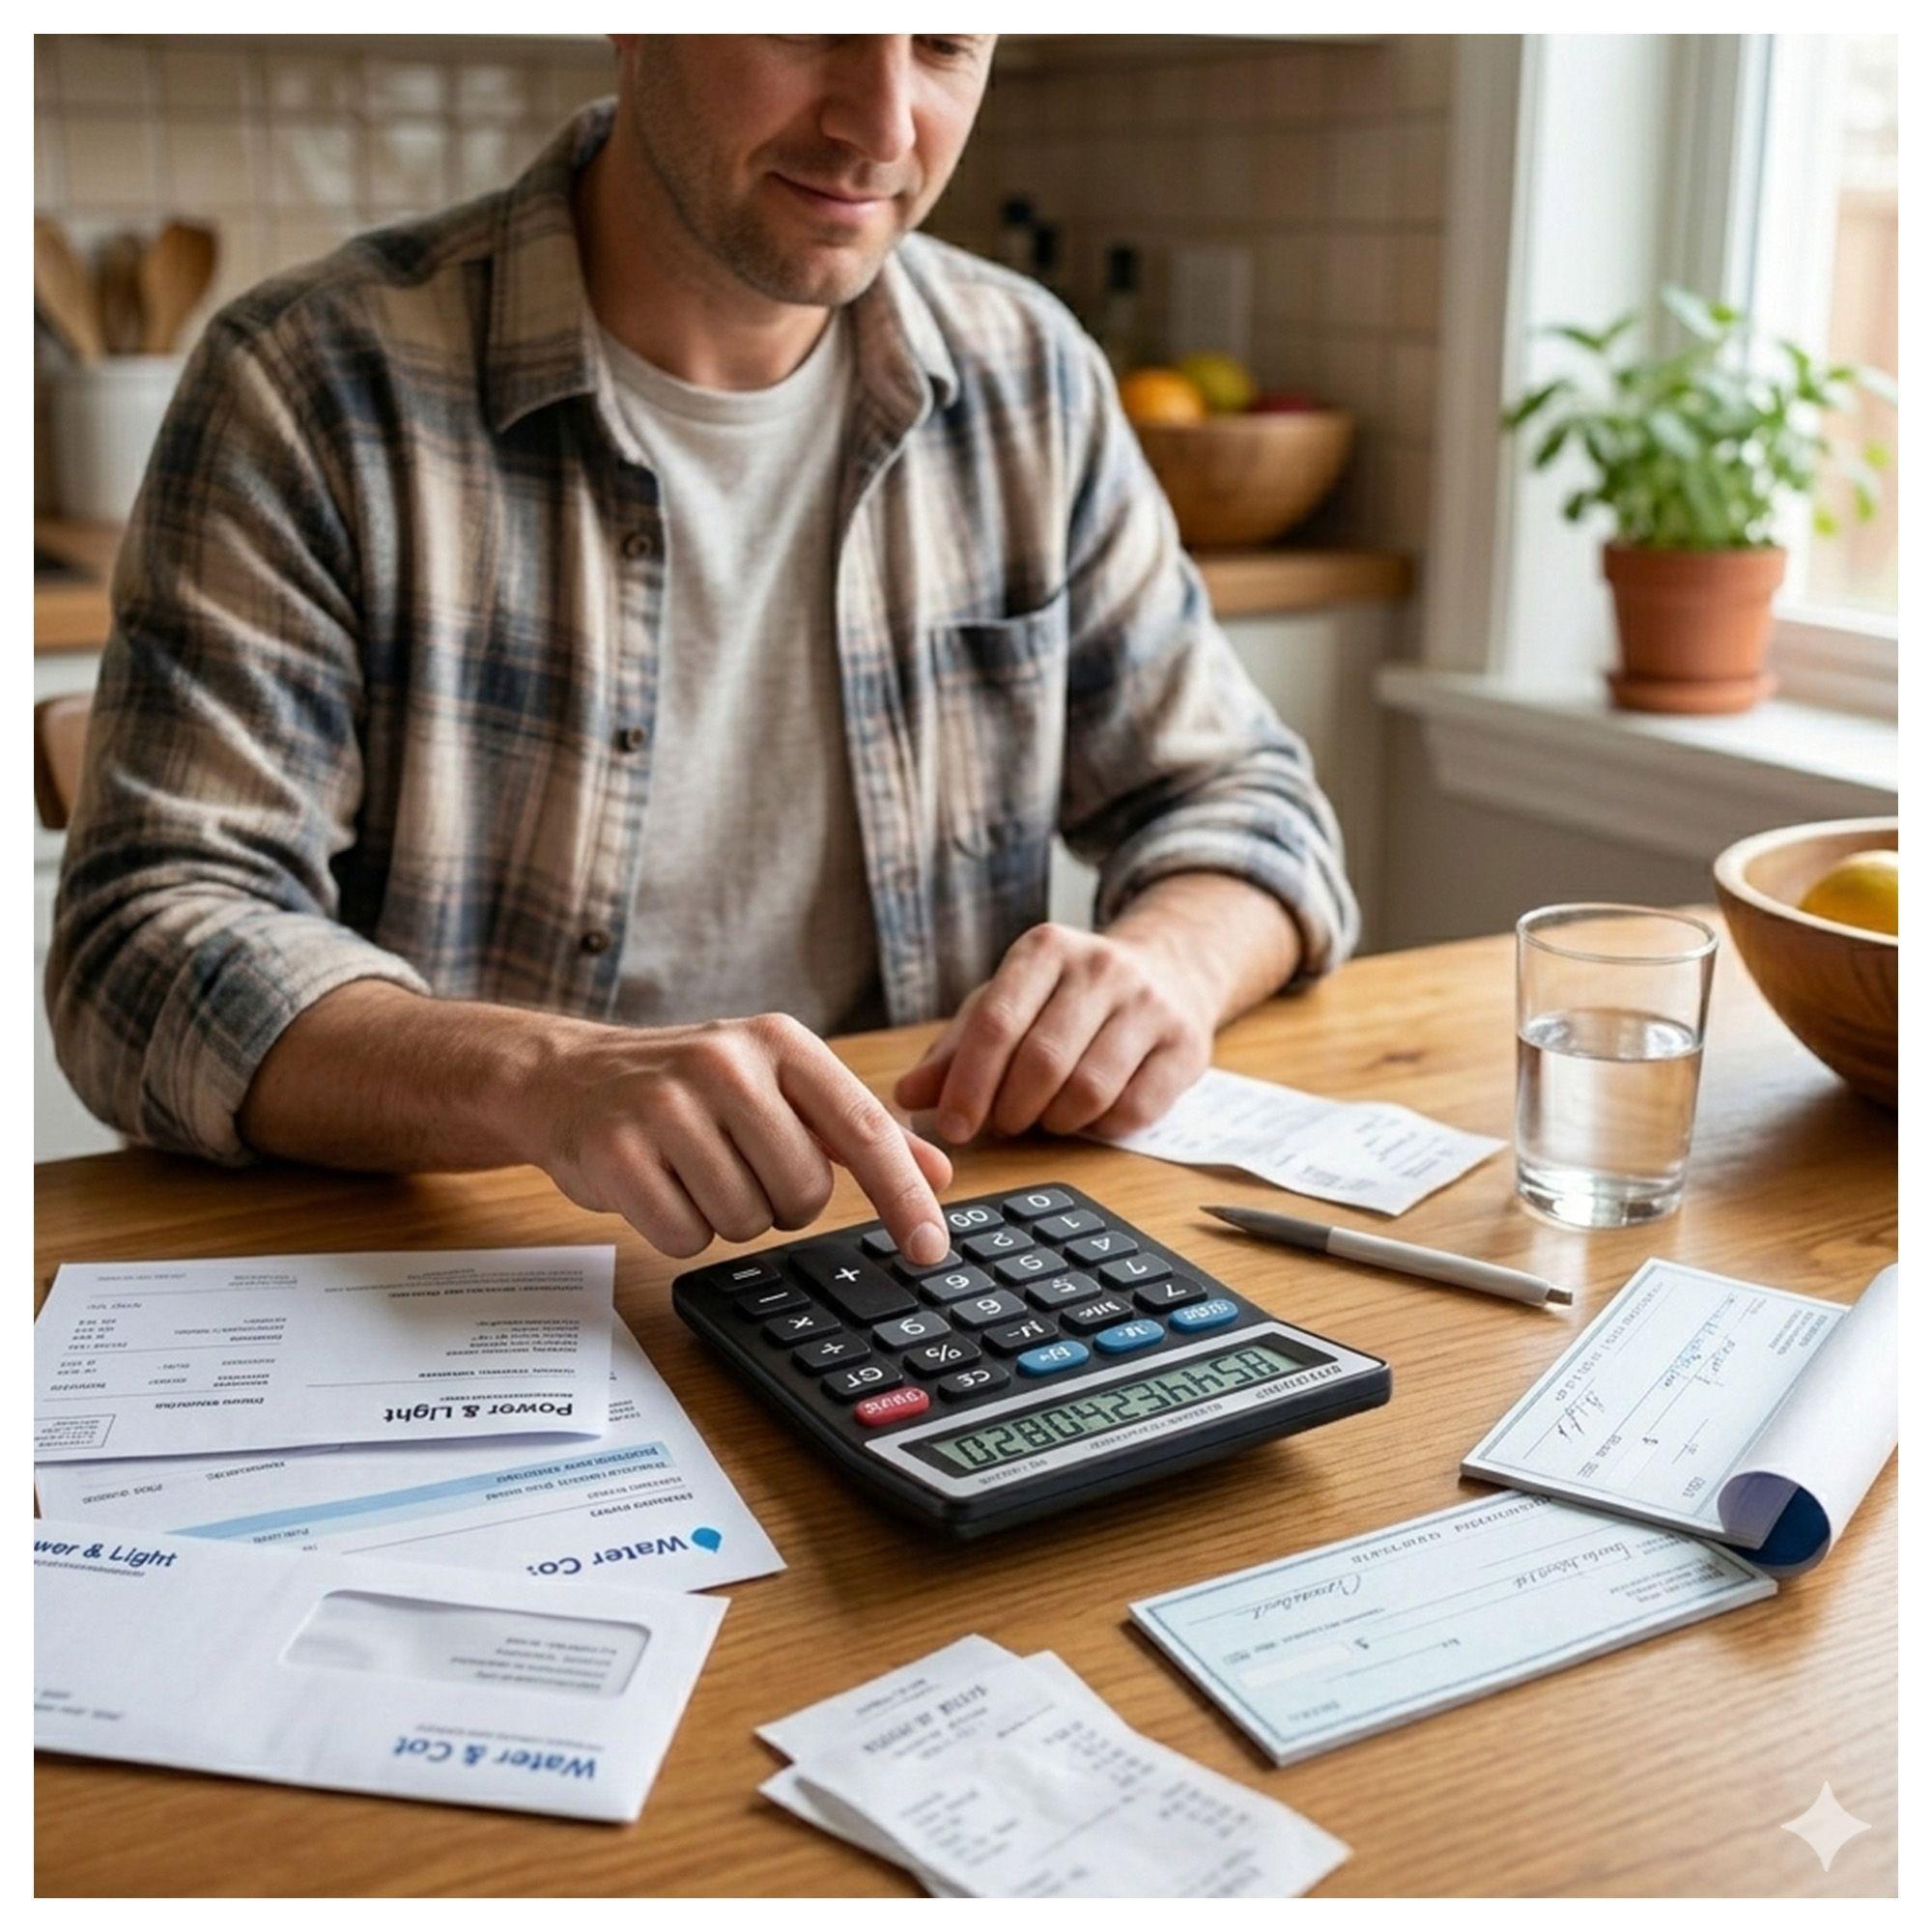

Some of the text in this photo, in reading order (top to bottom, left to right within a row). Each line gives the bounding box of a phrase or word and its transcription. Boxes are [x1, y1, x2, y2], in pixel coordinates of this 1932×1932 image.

[383, 1404, 453, 1423] Light
[83, 1543, 103, 1559] &
[109, 1546, 178, 1568] Light
[591, 1535, 690, 1566] Water
[493, 1747, 597, 1779] Water
